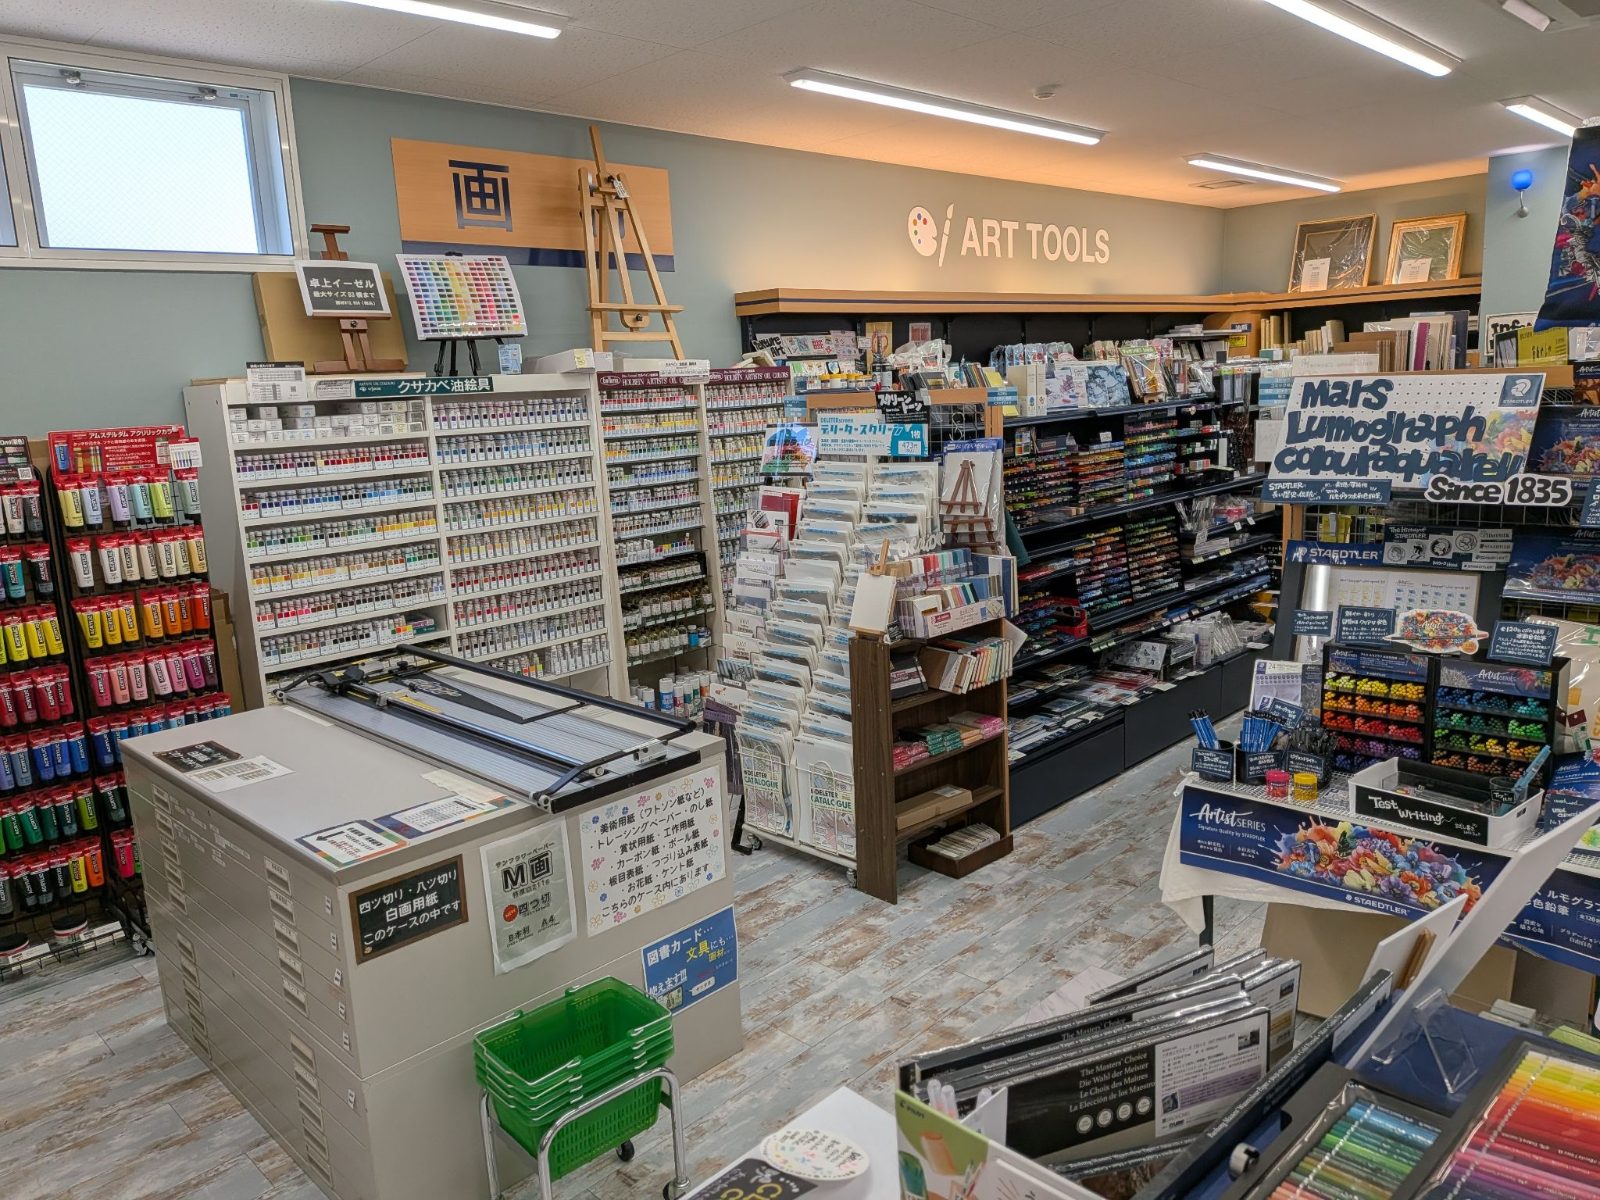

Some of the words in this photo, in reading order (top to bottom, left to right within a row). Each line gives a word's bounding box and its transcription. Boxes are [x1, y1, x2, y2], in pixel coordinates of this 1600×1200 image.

[449, 160, 513, 232] 画
[961, 217, 1019, 258] ART
[1026, 223, 1110, 264] TOOLS
[398, 378, 490, 394] クサカベ油絵具
[623, 377, 645, 386] HOLBEIN
[647, 376, 668, 385] ARTISTS
[744, 372, 763, 380] ARTISTS
[773, 371, 789, 379] COLORS
[878, 393, 912, 406] スクリーン
[1301, 379, 1394, 409] Mars
[130, 429, 173, 437] アクリリックカラ
[1286, 406, 1487, 446] Lumograph
[1427, 476, 1500, 503] Since
[1506, 477, 1568, 503] 1835
[1309, 548, 1378, 560] STAEDTLER
[1269, 662, 1276, 670] 24
[1189, 803, 1253, 827] Artist
[1237, 818, 1266, 832] SERIES
[1368, 795, 1399, 809] Test
[1398, 808, 1444, 825] Writing
[495, 842, 555, 868] サンフラワーペーパー
[501, 850, 553, 892] M画
[359, 868, 457, 914] 四ツ切り・八ツ切り
[518, 892, 552, 915] 四つ切
[602, 863, 709, 918] こちらのケース内にあります
[385, 891, 439, 922] 白画用紙
[1354, 896, 1409, 916] STAEDTLER
[1526, 899, 1569, 916] 色鉛筆
[364, 900, 460, 945] このケースの中です
[1079, 1079, 1092, 1089] Die
[1093, 1072, 1111, 1084] Wahl
[1112, 1069, 1123, 1079] der
[1124, 1062, 1149, 1075] Meister
[1080, 1068, 1094, 1077] The
[1095, 1058, 1123, 1073] Masters'
[1124, 1053, 1147, 1065] Choice
[1069, 1104, 1078, 1113] La
[1109, 1091, 1117, 1100] de
[1118, 1088, 1128, 1098] los
[1129, 1080, 1156, 1094] Maestro
[1080, 1090, 1088, 1099] Le
[1089, 1083, 1110, 1096] Choix
[1111, 1080, 1123, 1089] des
[906, 1106, 925, 1119] PILOT
